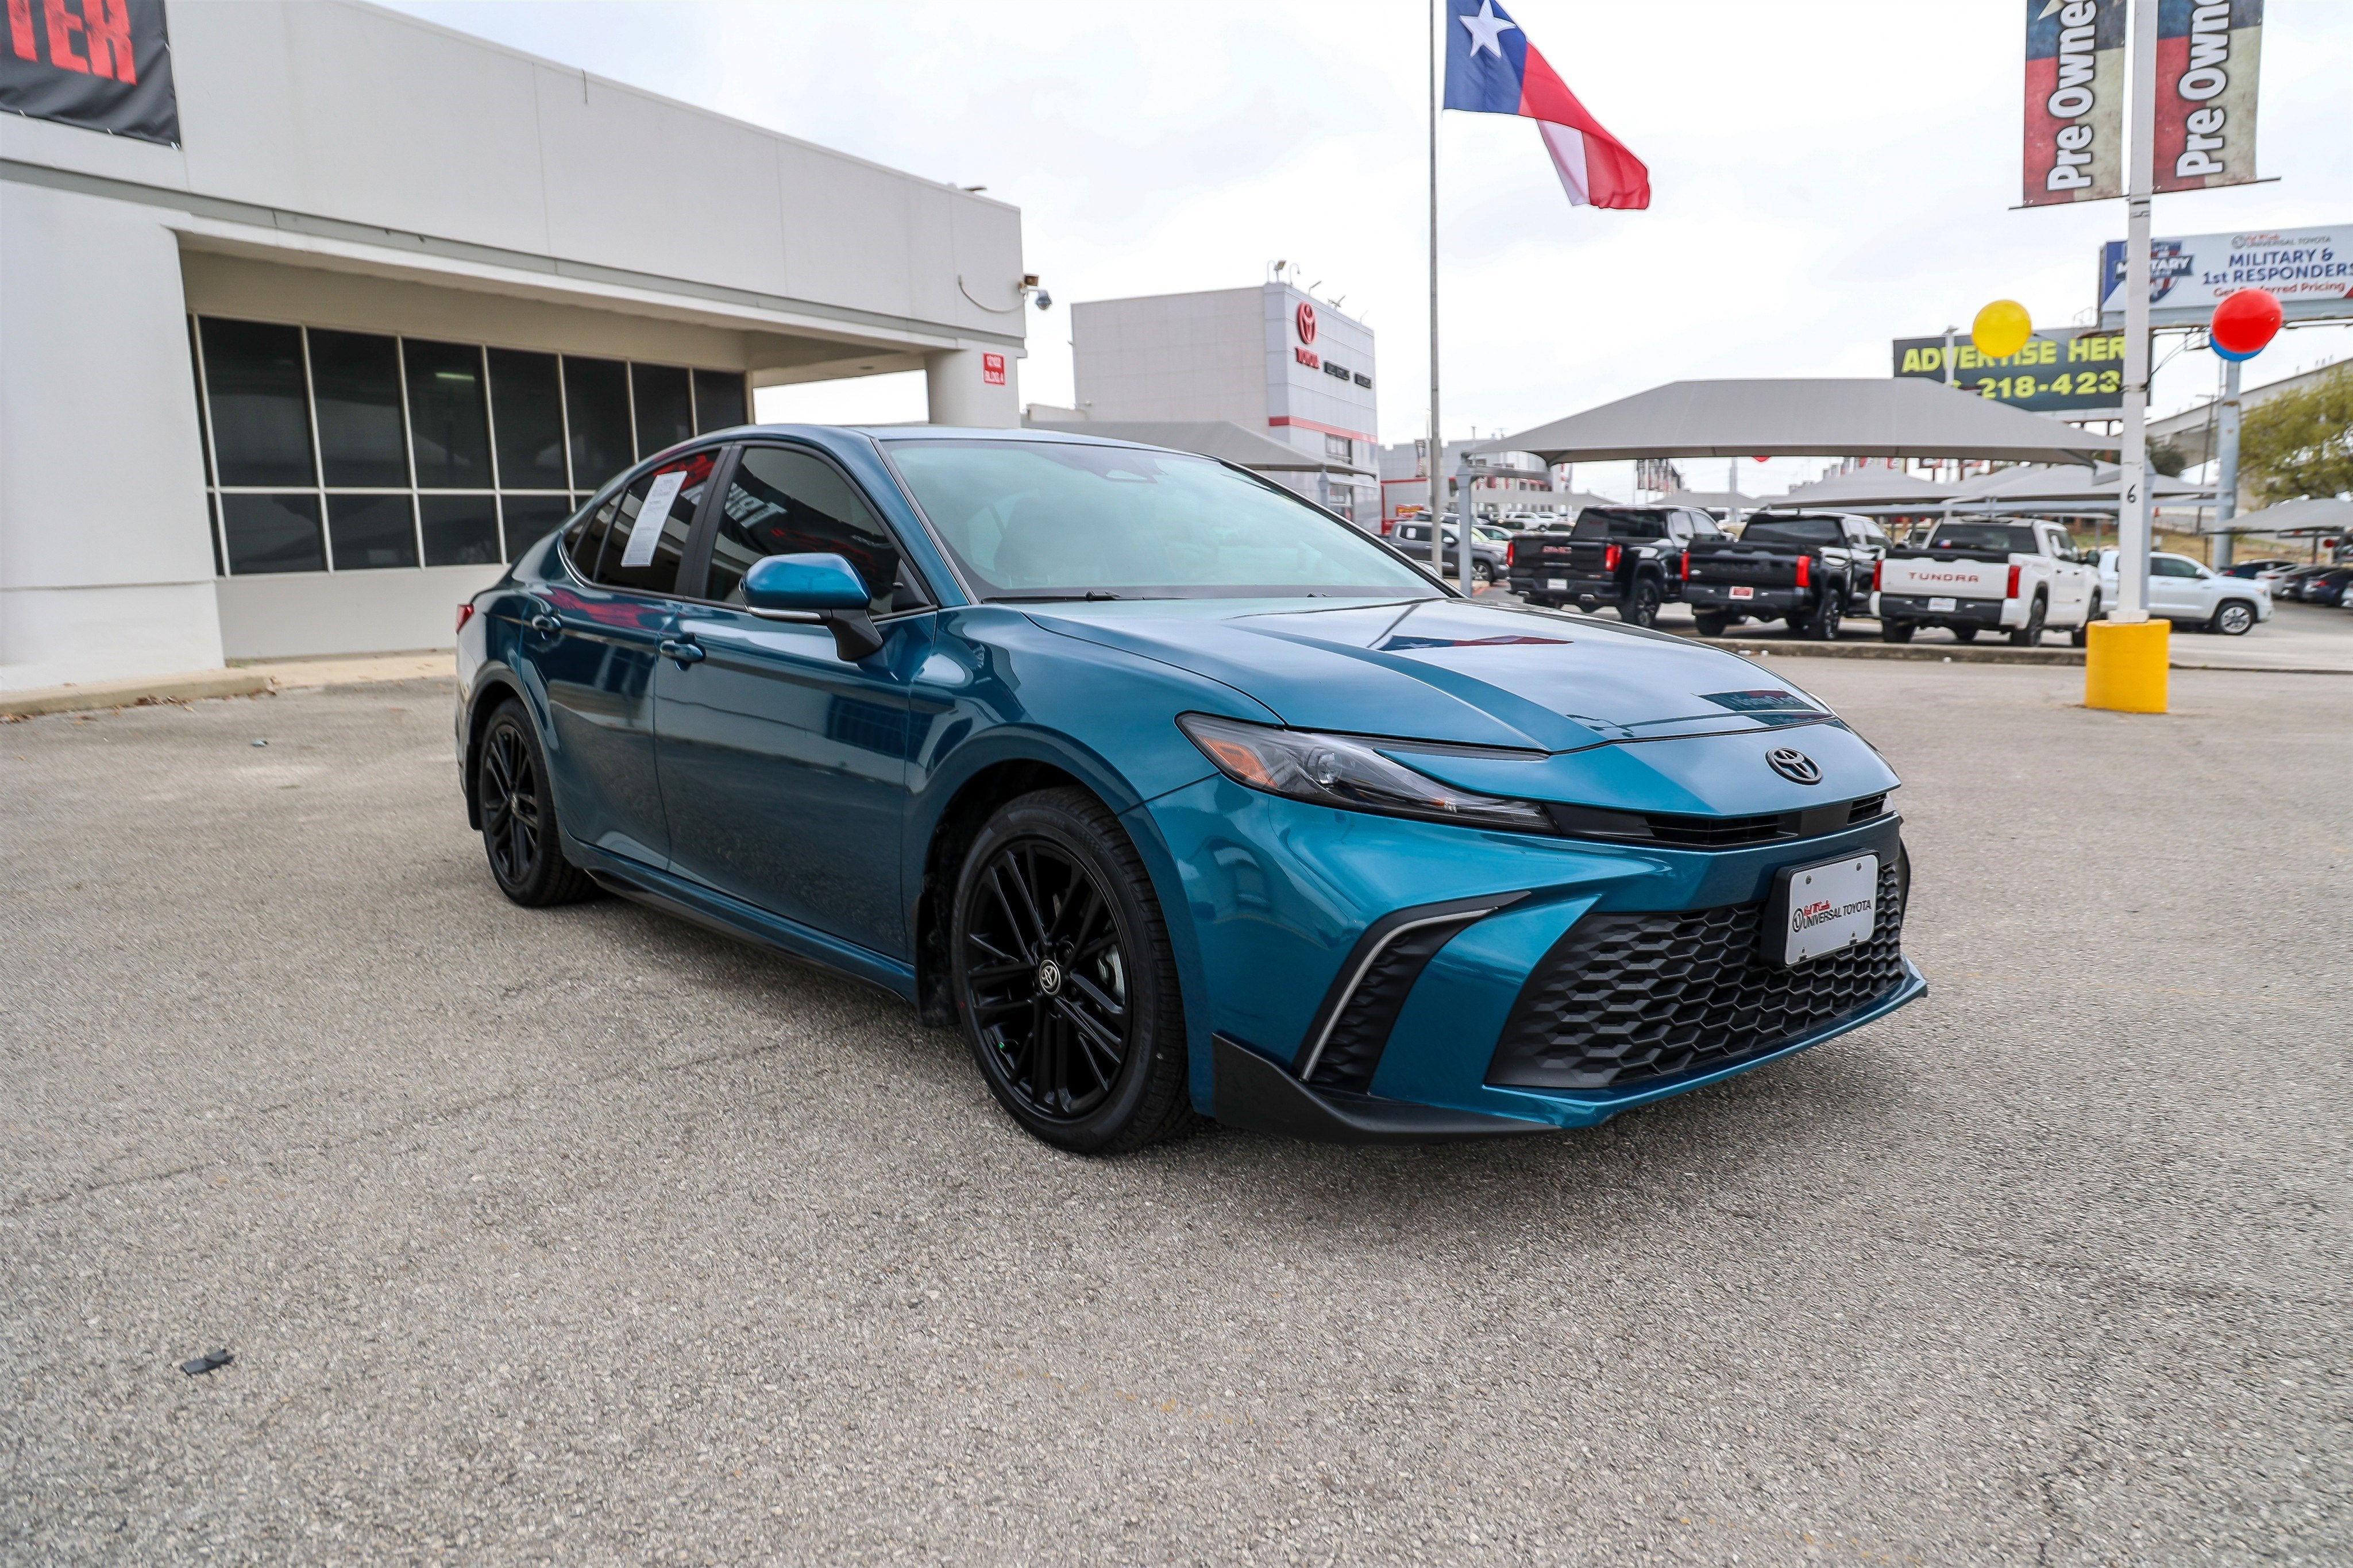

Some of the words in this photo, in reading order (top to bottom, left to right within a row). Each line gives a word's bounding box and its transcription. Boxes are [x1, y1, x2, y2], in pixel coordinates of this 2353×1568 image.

[2178, 0, 2229, 101] Own
[2176, 107, 2224, 177] Pre
[2047, 125, 2092, 191] Pre
[2116, 256, 2190, 274] MTARY
[2229, 248, 2317, 268] MILITARY
[2321, 247, 2334, 261] &
[2203, 271, 2228, 285] 1st
[2301, 283, 2346, 293] Pricing
[2069, 336, 2125, 363] HER
[2127, 484, 2136, 503] 6
[1908, 572, 1978, 582] TUNDRA
[1803, 907, 1842, 929] UNIVERSAL
[1842, 899, 1872, 917] TOYOTA
